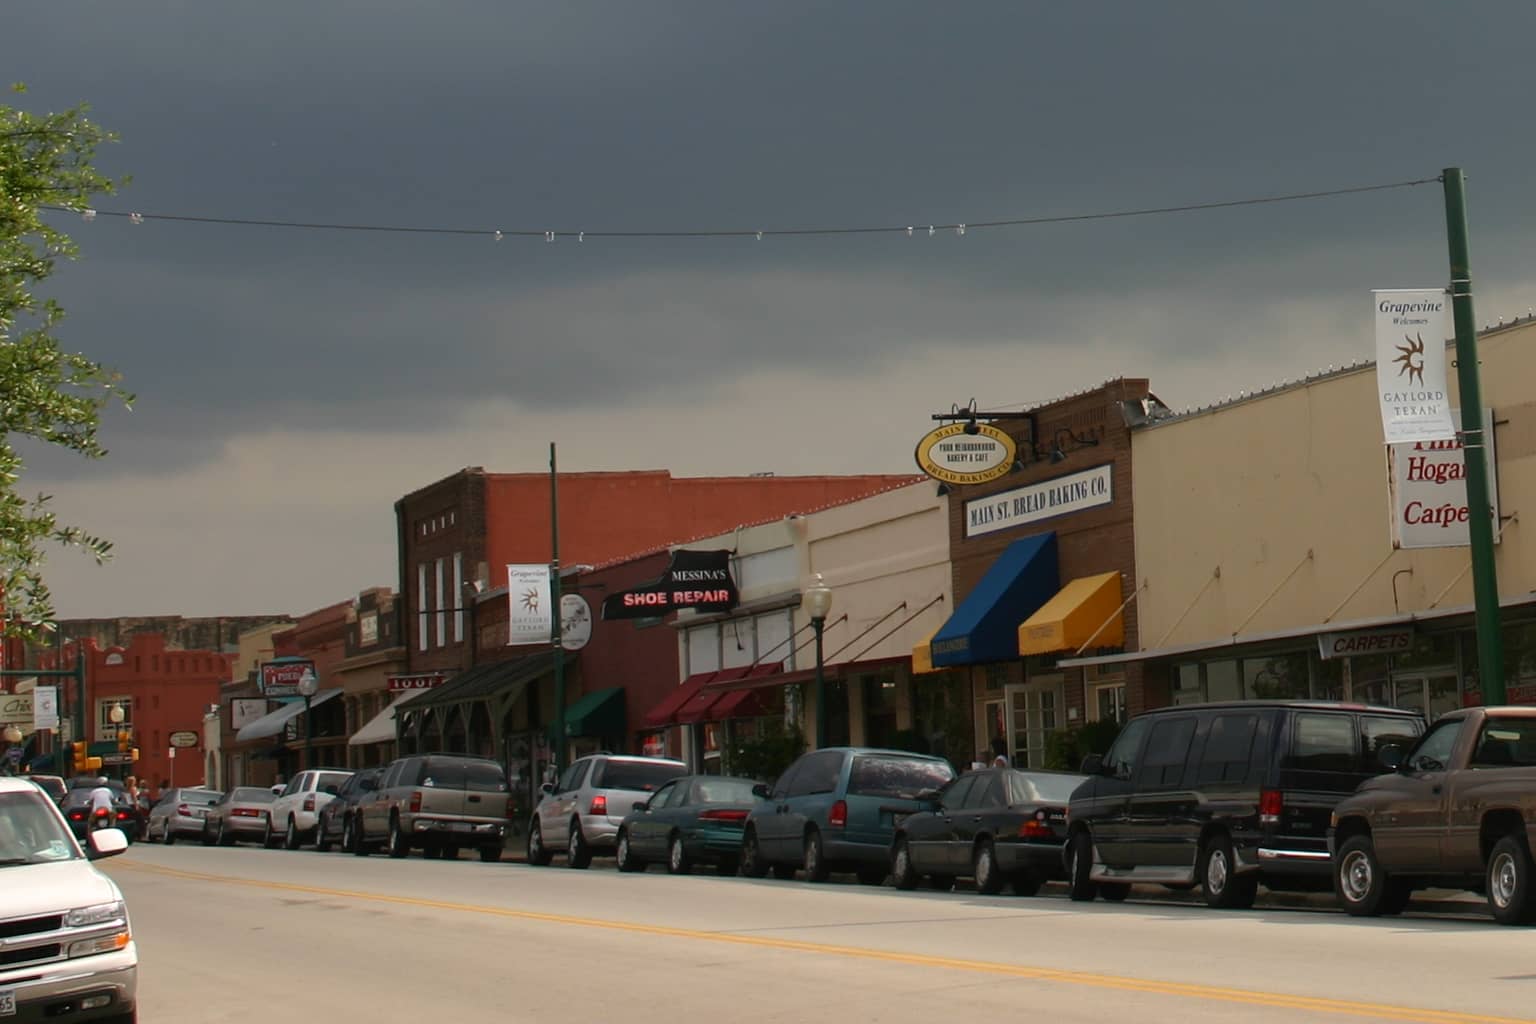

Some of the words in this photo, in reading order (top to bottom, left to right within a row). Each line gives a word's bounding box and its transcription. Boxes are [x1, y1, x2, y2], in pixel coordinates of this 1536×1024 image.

[1379, 299, 1442, 316] Grapevine
[1383, 391, 1443, 403] GAYLORD
[970, 505, 995, 527] MAIN
[997, 500, 1011, 520] ST.
[1013, 491, 1047, 517] BREAD
[1049, 480, 1088, 507] BAKING
[1090, 475, 1108, 497] CO.
[672, 568, 727, 582] MESSINA'S
[623, 591, 668, 607] SHOE
[673, 588, 729, 604] REPAIR
[1334, 633, 1409, 653] CARPETS
